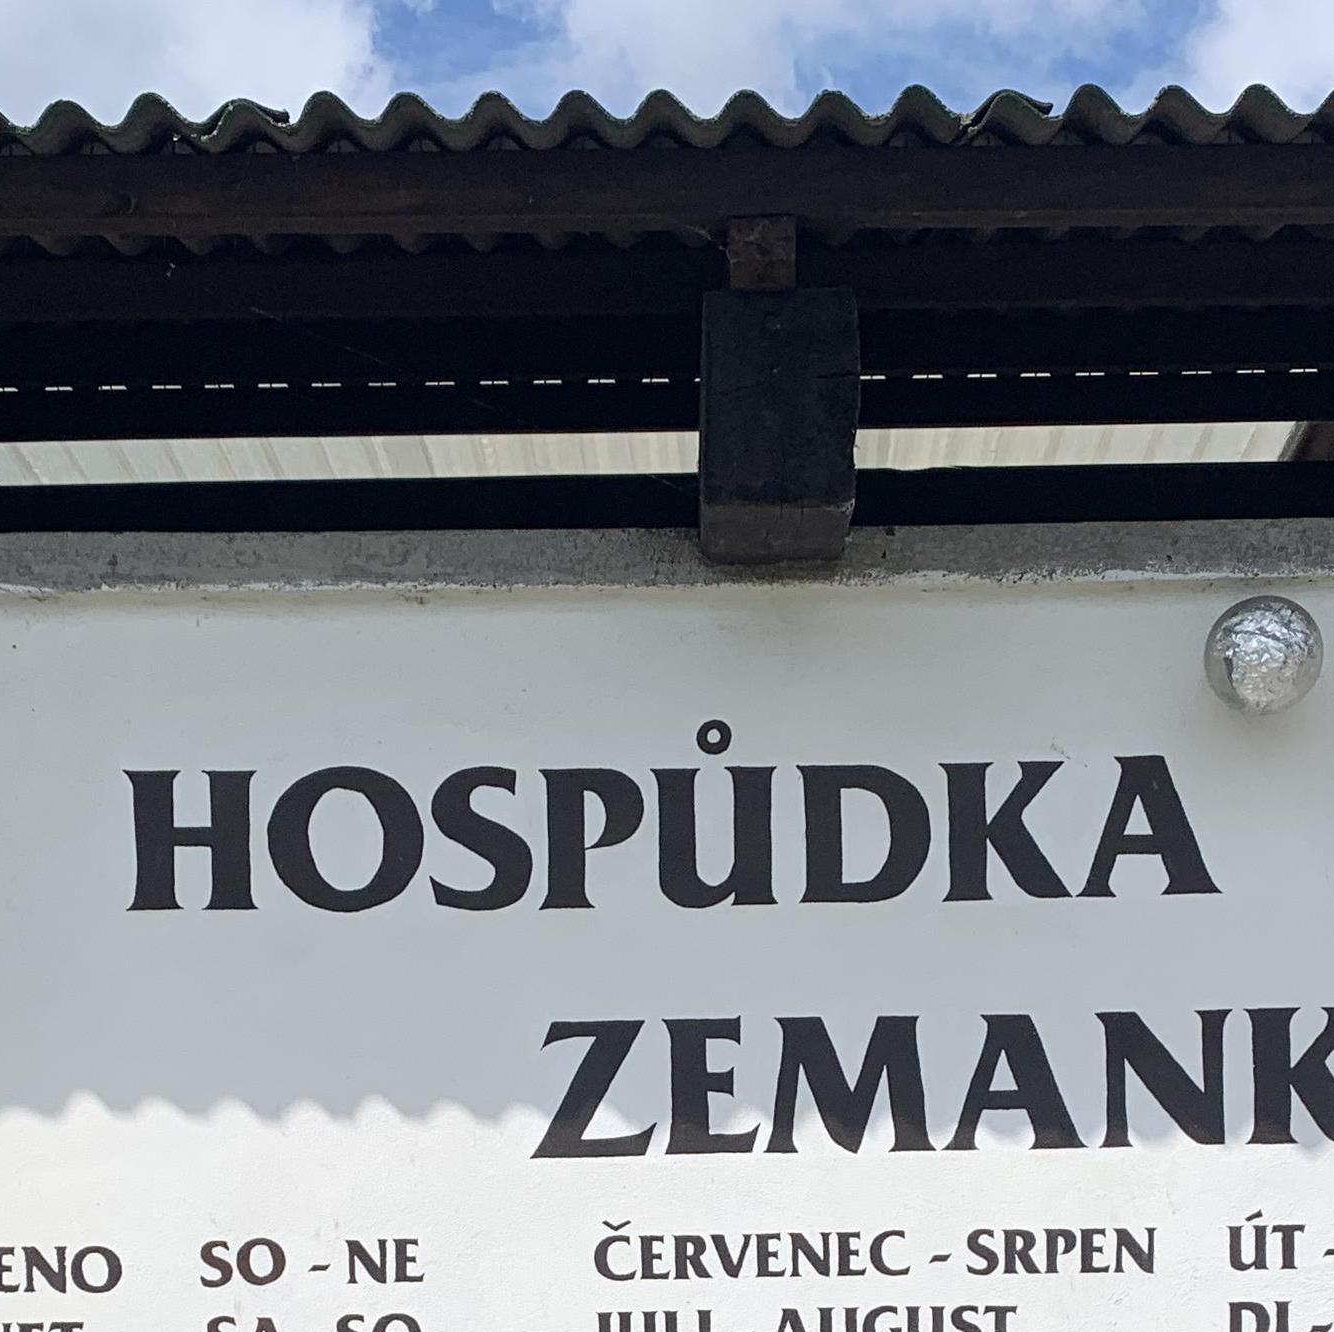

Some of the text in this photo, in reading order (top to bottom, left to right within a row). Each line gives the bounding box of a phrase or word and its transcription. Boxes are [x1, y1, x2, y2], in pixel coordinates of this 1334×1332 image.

[121, 718, 1224, 915] HOSPŮDKA
[198, 1236, 288, 1290] SO
[344, 1237, 426, 1286] NE
[592, 1219, 912, 1283] ČERVENEC
[964, 1226, 1158, 1277] SRPEN
[1226, 1208, 1307, 1273] ÚT
